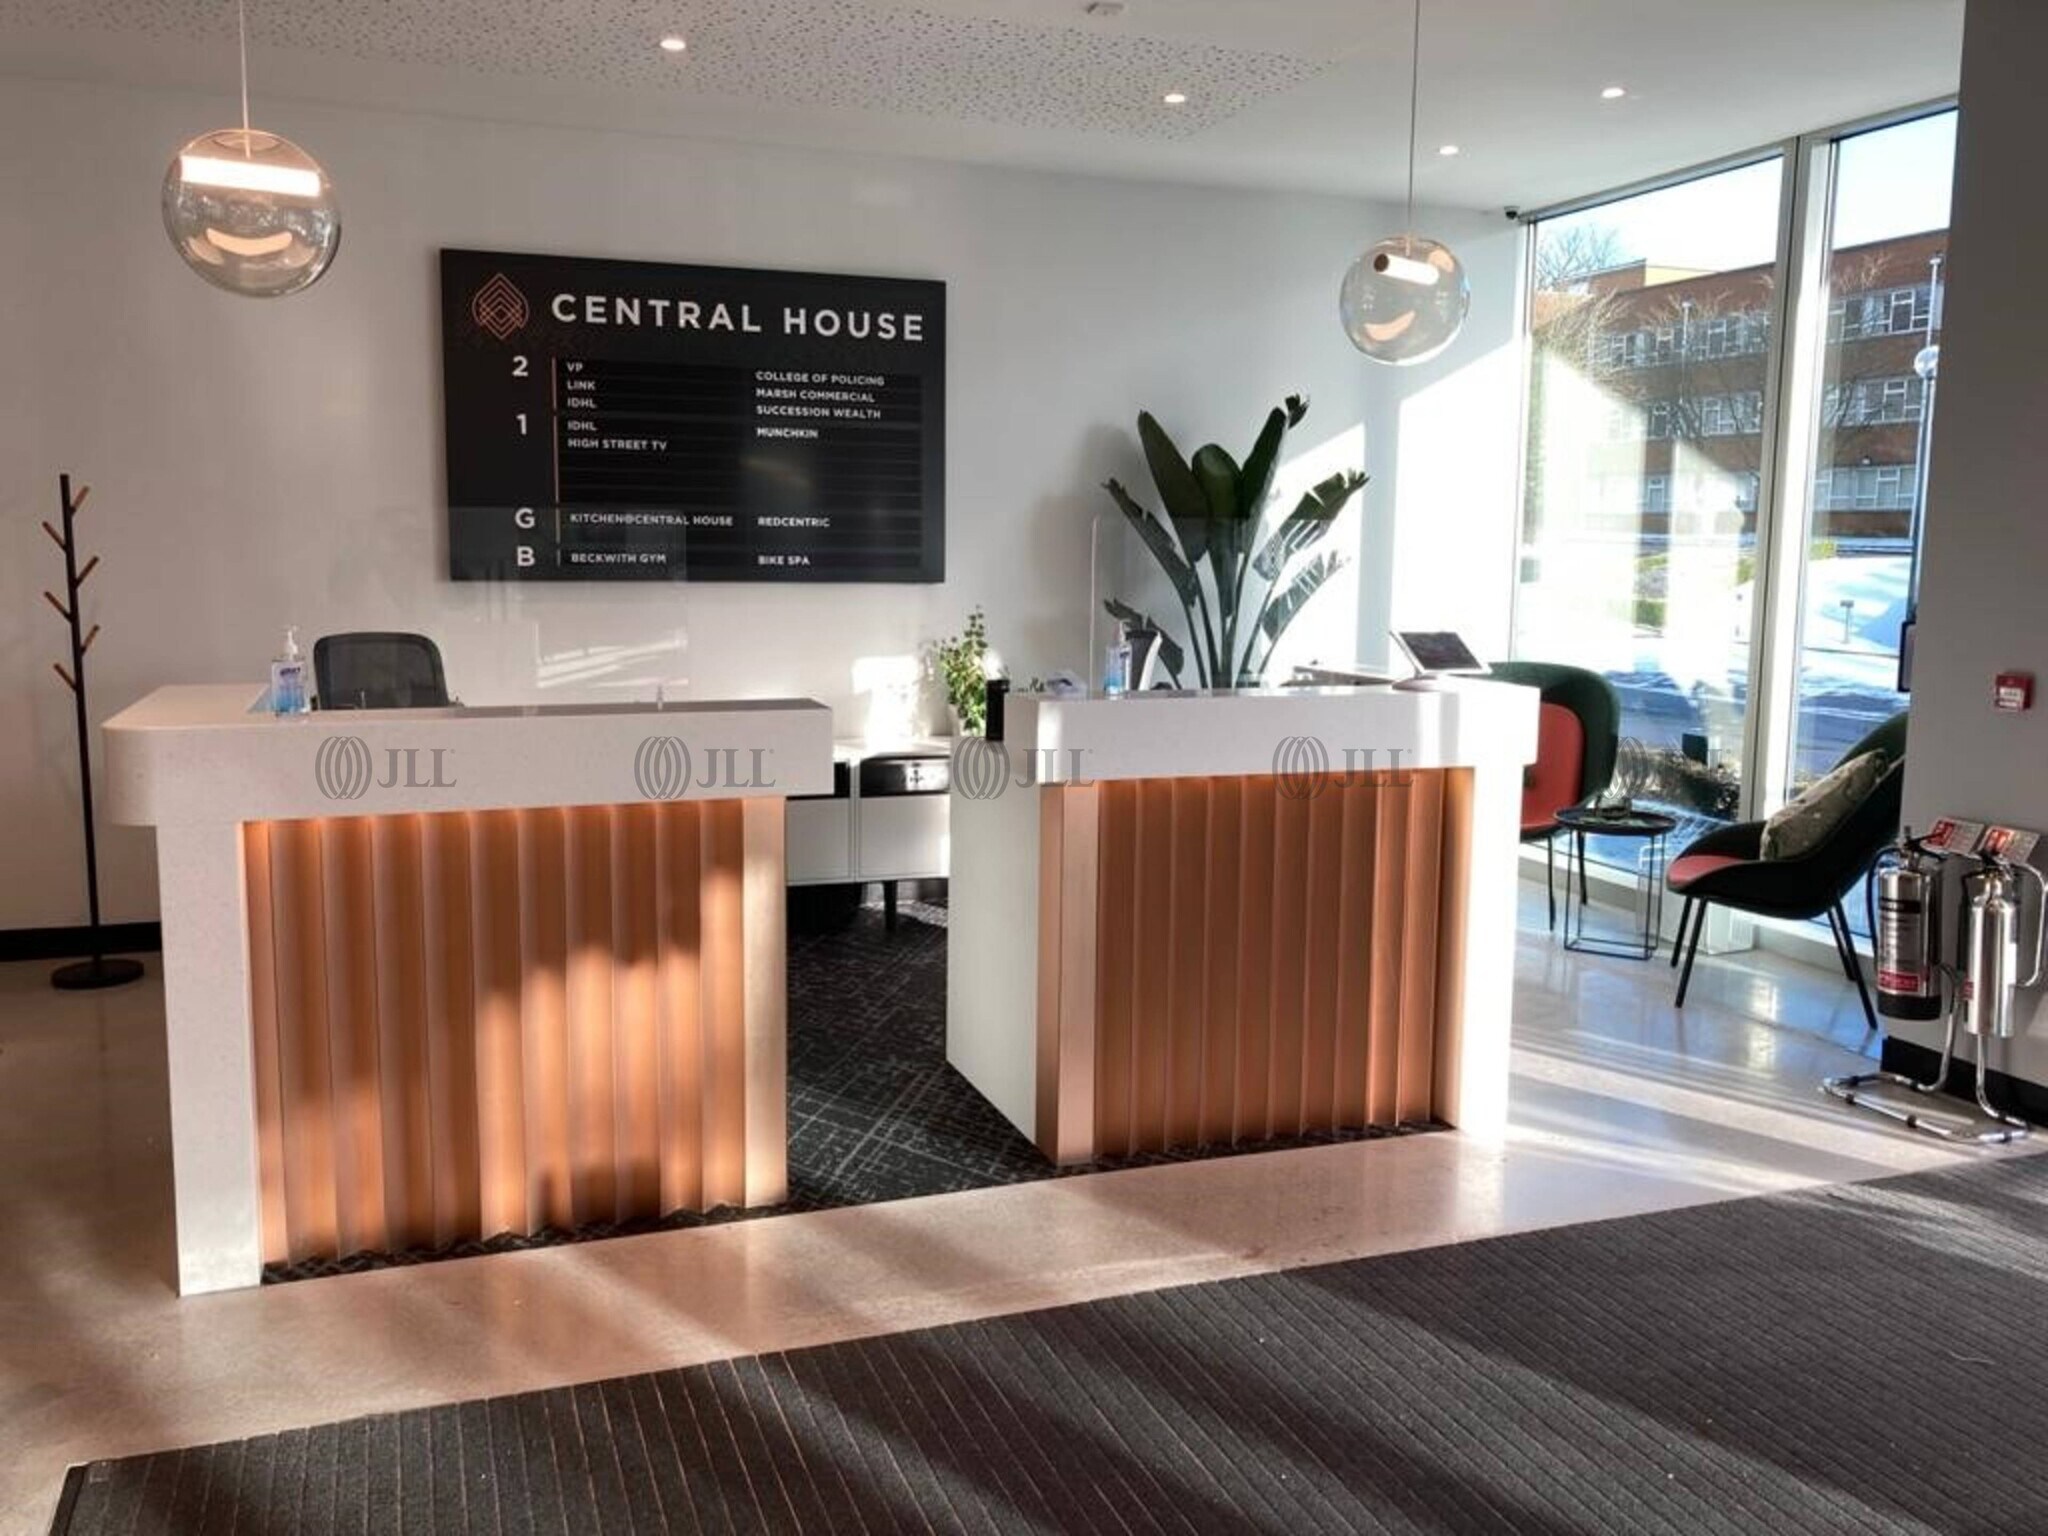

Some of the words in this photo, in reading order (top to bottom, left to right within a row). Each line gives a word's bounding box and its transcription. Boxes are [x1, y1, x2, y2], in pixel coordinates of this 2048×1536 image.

[551, 293, 762, 333] CENTRAL
[783, 307, 924, 342] HOUSE
[512, 356, 528, 377] 2
[755, 371, 808, 383] COLLEGE
[812, 374, 828, 383] OF
[831, 375, 884, 386] POLICING
[567, 381, 596, 391] LINK
[756, 388, 796, 399] MARSH
[800, 390, 875, 402] COMMERCIAL
[568, 398, 596, 408] IDHL
[756, 405, 829, 417] SUCCESSION
[833, 408, 881, 419] WEALTH
[516, 414, 527, 435] 1
[568, 421, 597, 431] IDHL
[568, 438, 599, 449] HIGH
[602, 440, 647, 450] STREET
[652, 441, 667, 451] TV
[515, 508, 535, 528] G
[693, 515, 733, 526] HOUSE
[758, 516, 830, 527] REDCENTRIC
[517, 546, 535, 566] B
[571, 553, 636, 563] BECKWITH
[640, 553, 666, 563] GYM
[758, 555, 784, 565] BIKE
[788, 556, 810, 565] SPA
